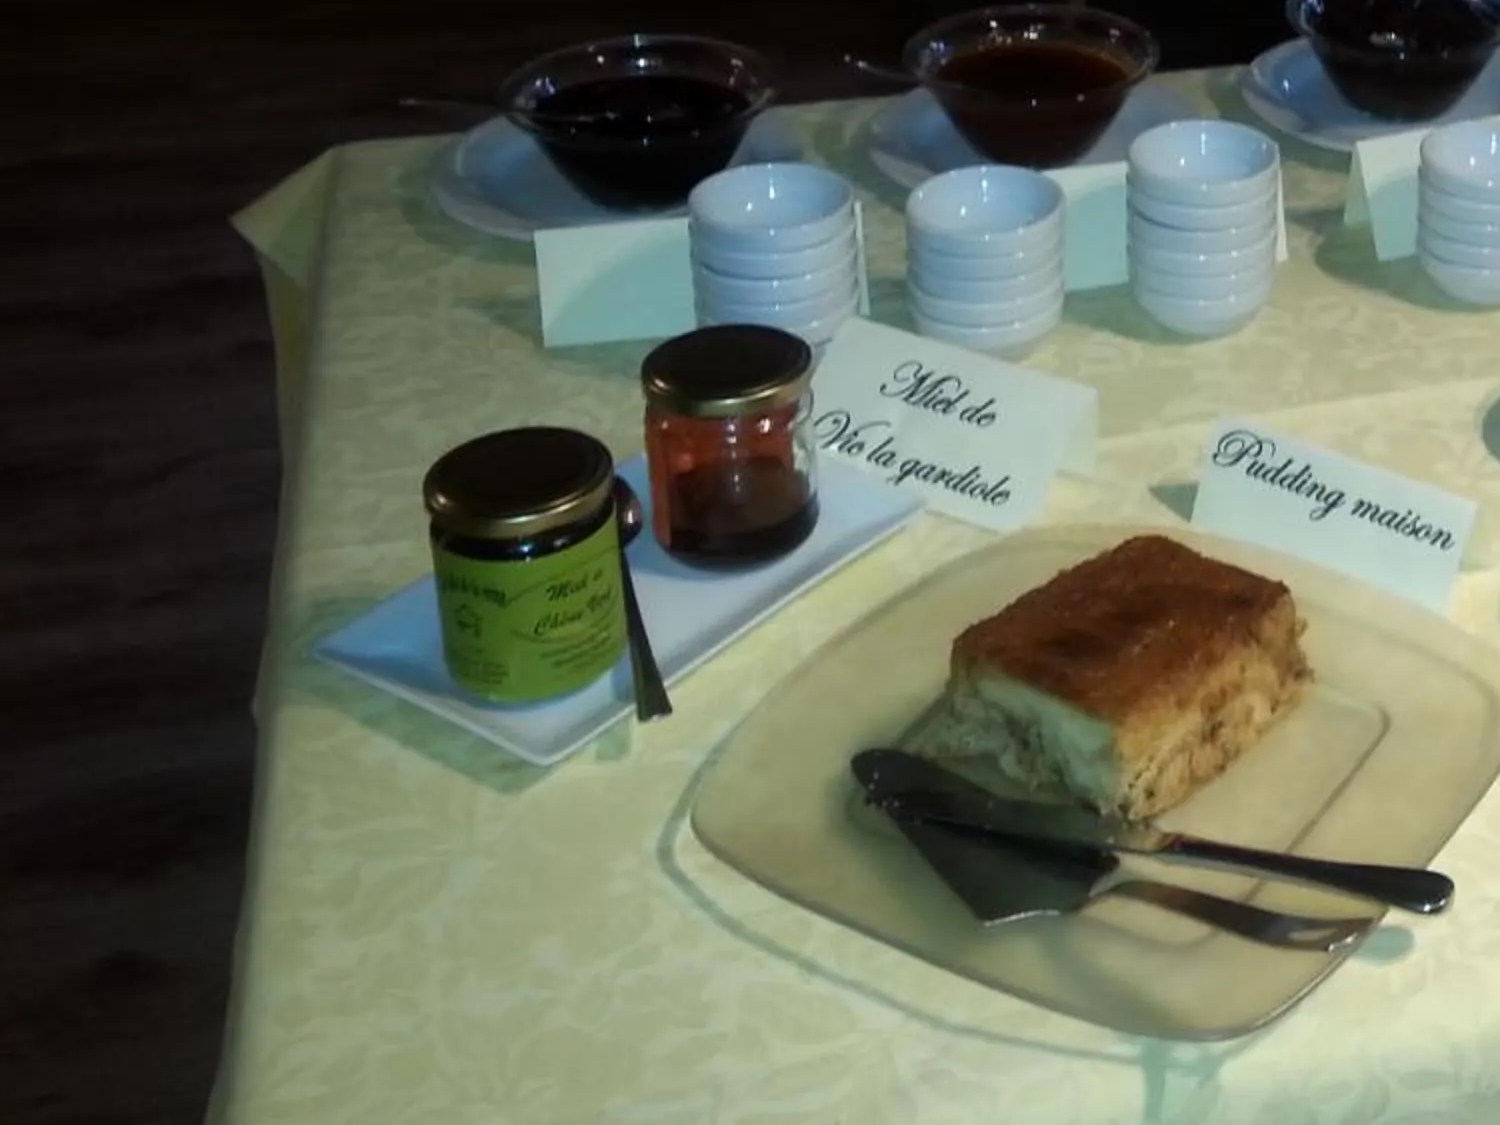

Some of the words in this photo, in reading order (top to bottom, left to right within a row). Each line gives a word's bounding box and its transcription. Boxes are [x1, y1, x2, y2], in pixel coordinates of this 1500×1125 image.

[879, 360, 970, 415] Miel
[959, 397, 997, 427] de
[865, 436, 897, 468] la
[886, 458, 1011, 506] gardiole
[1211, 429, 1347, 522] Pudding
[1350, 496, 1457, 551] maison
